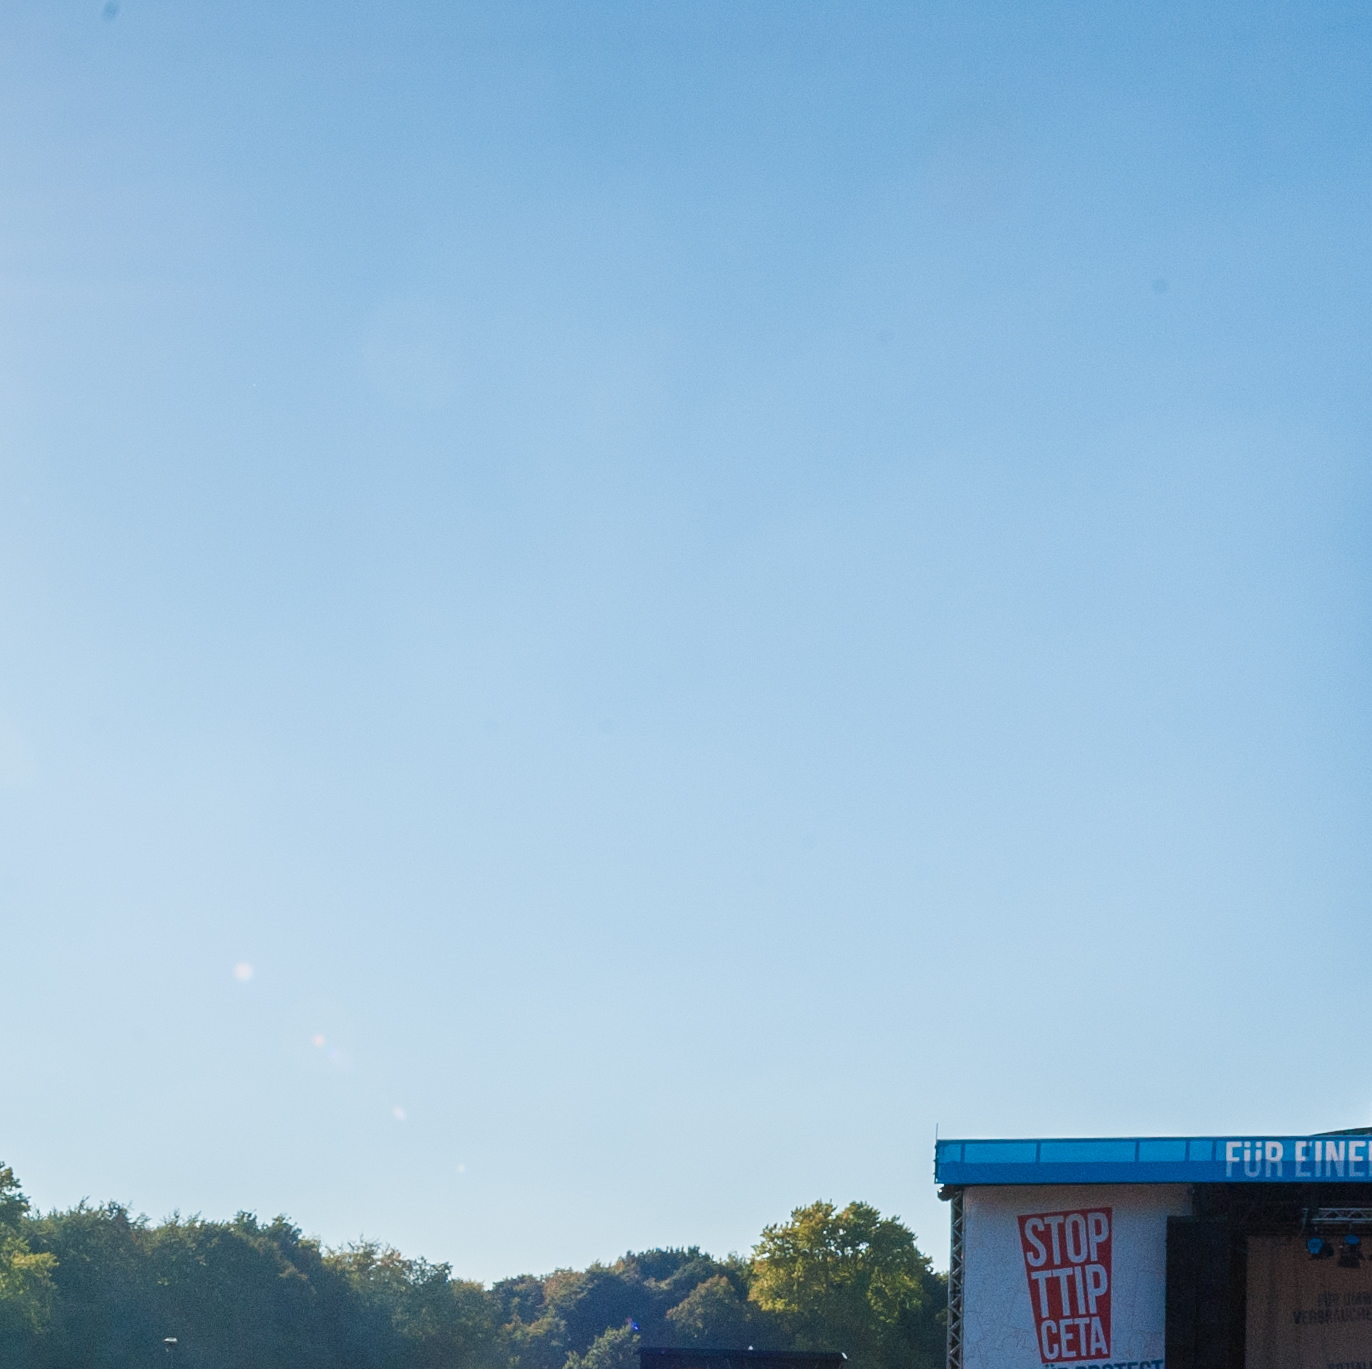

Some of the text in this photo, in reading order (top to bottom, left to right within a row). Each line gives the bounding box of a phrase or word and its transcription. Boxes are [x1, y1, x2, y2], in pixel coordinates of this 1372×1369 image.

[1025, 1211, 1110, 1267] STOP
[1030, 1263, 1109, 1319] TTIP
[1040, 1316, 1109, 1360] CETA
